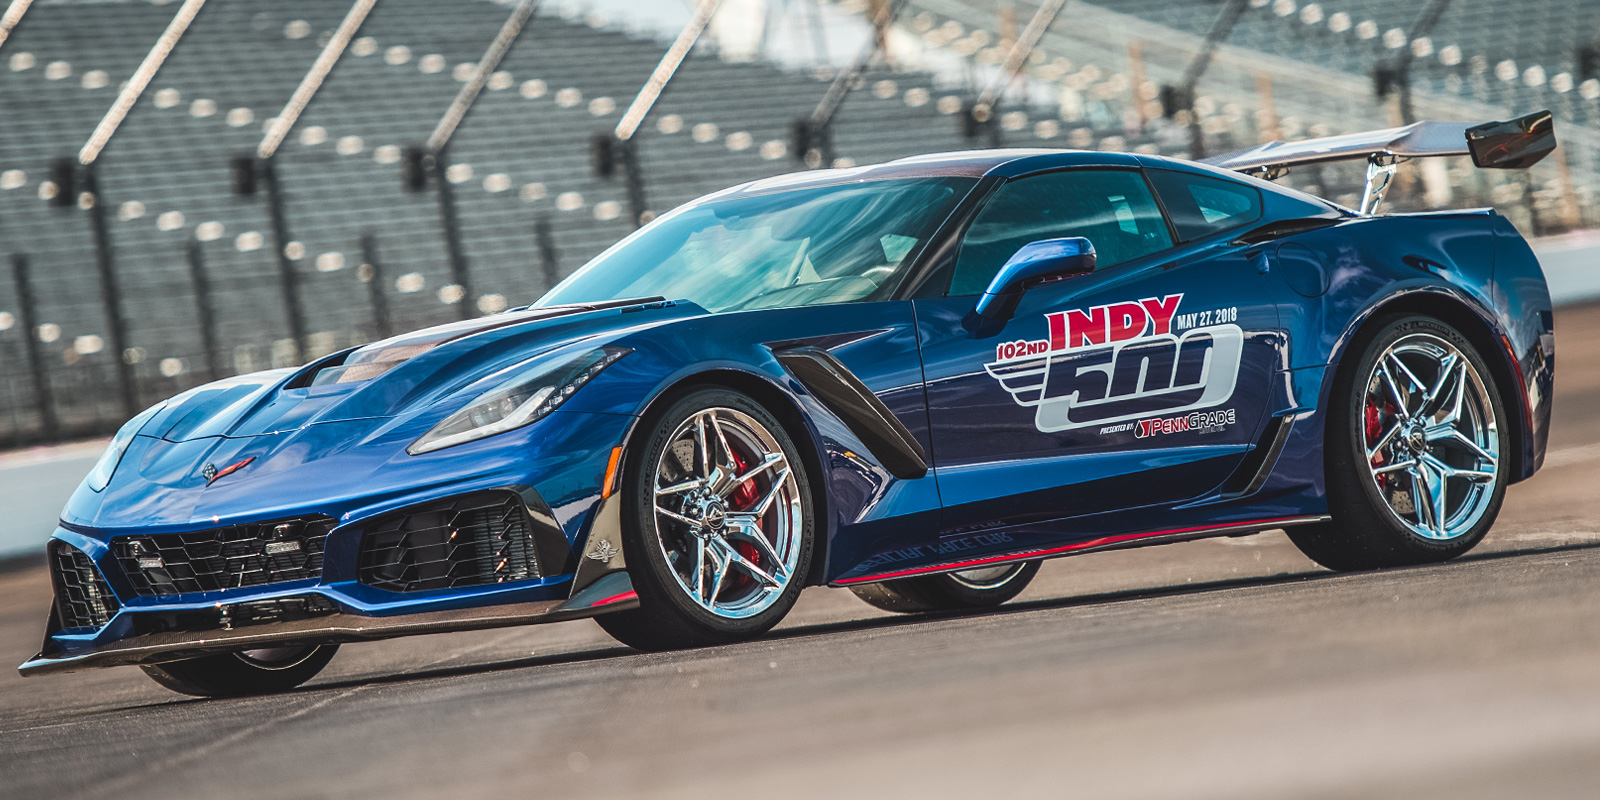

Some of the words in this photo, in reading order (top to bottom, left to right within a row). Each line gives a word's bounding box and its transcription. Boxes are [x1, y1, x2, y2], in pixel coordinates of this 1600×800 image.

[1045, 294, 1184, 350] INDY
[1177, 313, 1199, 330] MAY
[1215, 307, 1238, 325] 2018
[997, 340, 1049, 361] 102ND
[1035, 323, 1244, 433] 500
